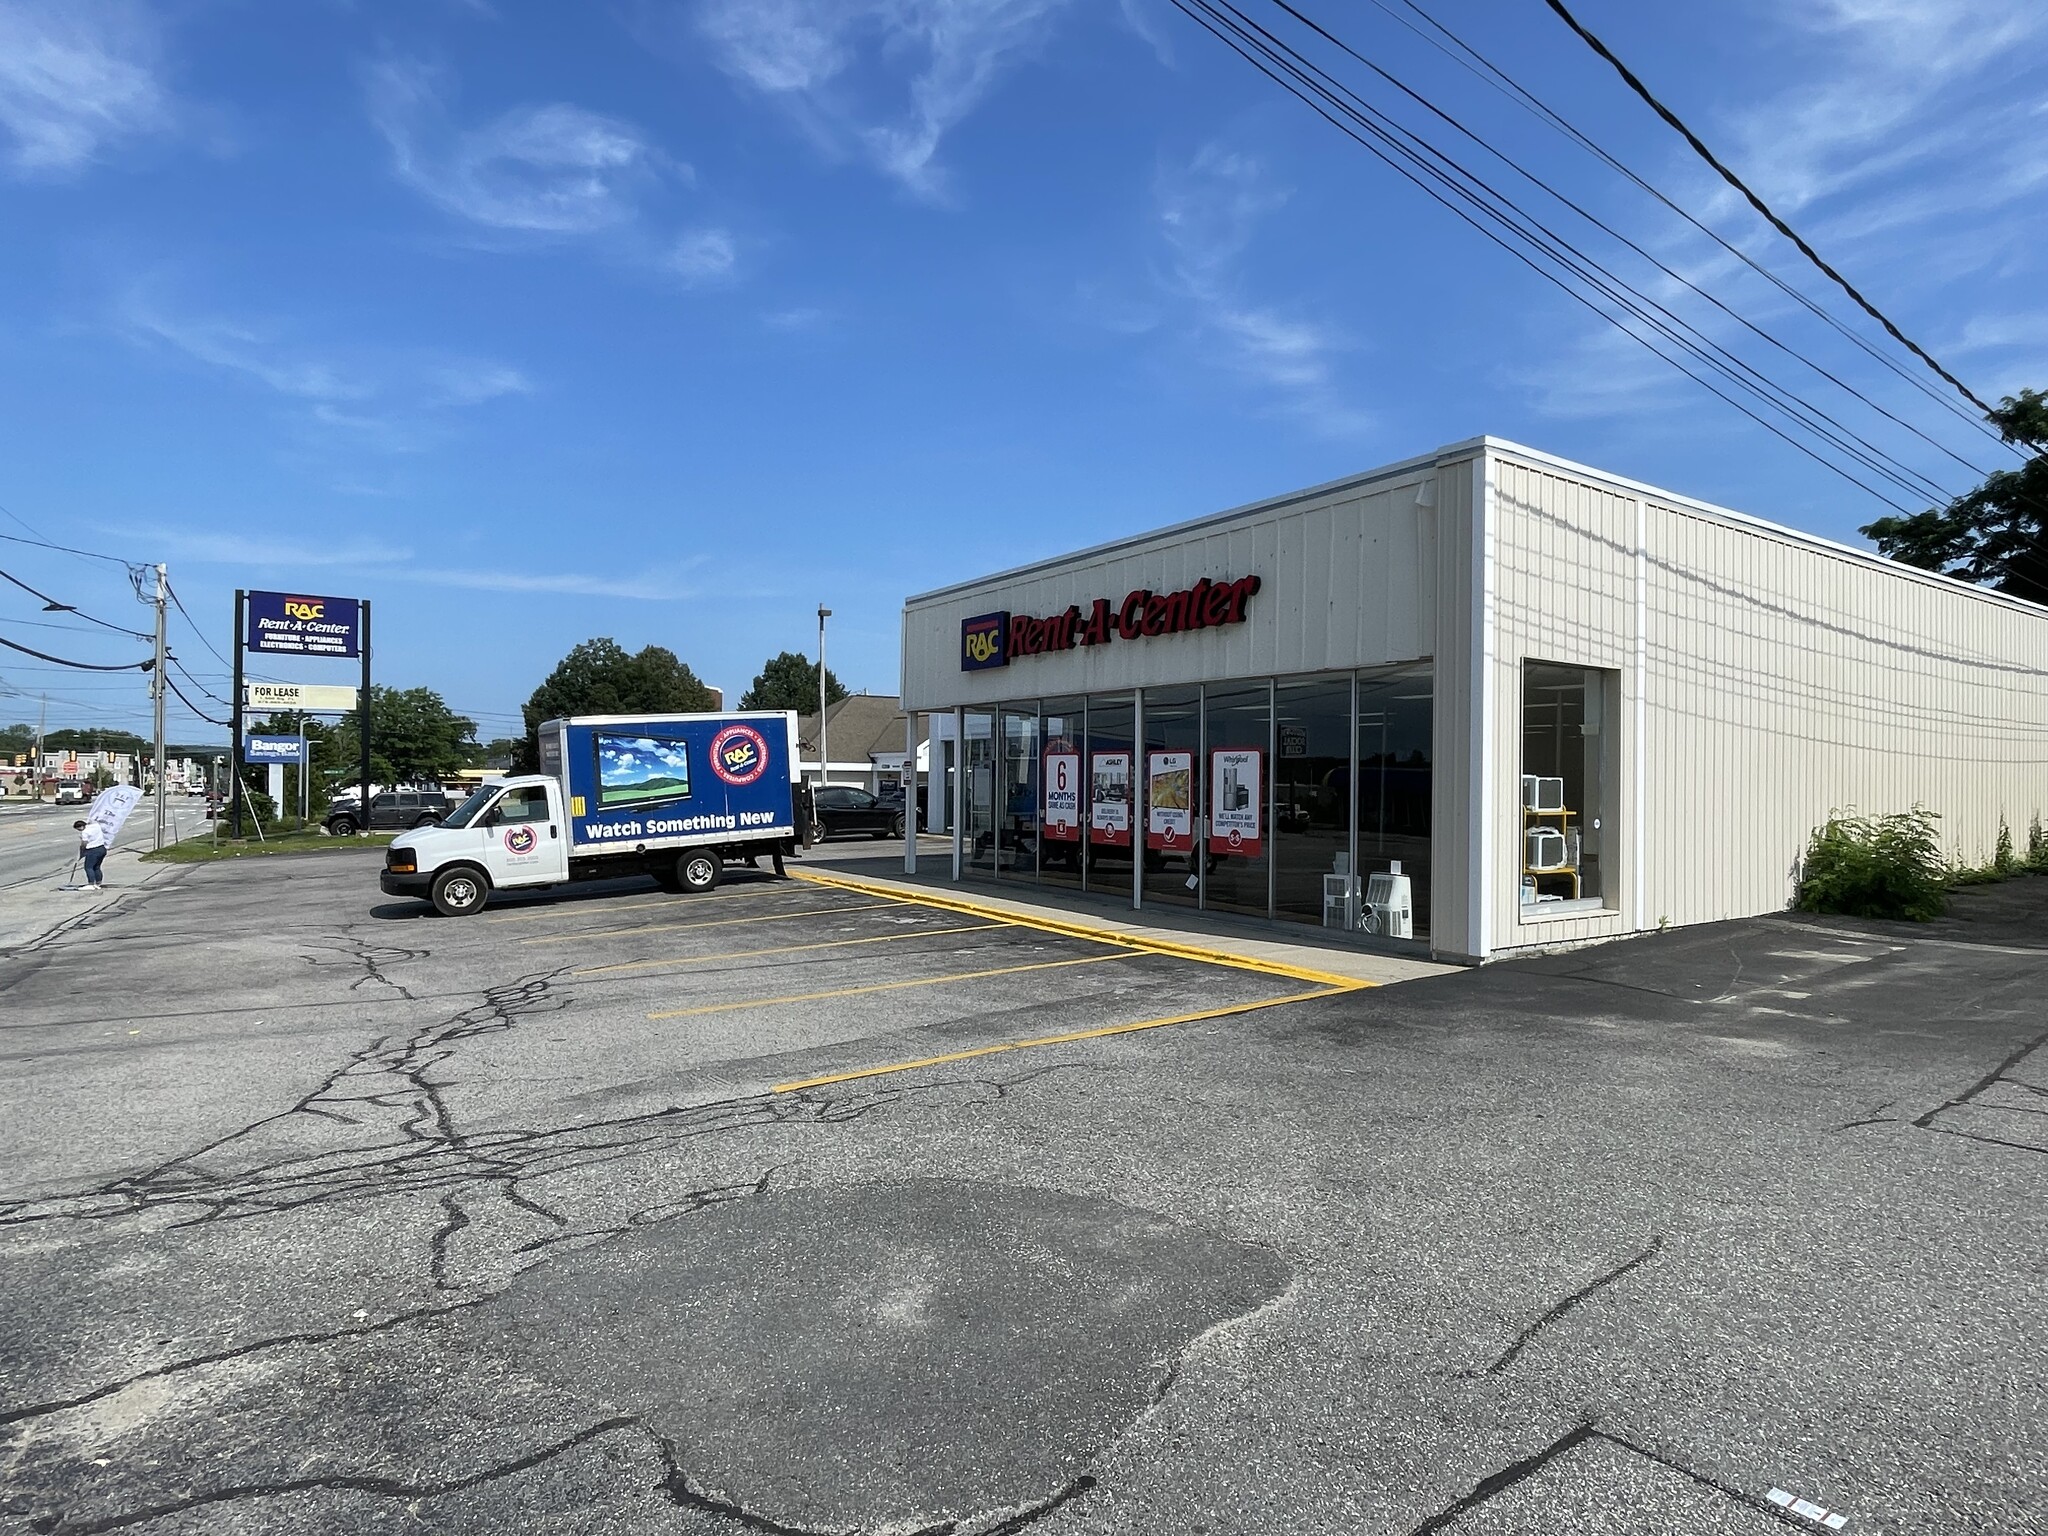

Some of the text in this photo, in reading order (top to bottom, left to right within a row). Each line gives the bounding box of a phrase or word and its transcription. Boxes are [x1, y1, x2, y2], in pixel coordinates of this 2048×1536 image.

[285, 602, 324, 620] RAC
[265, 633, 343, 644] FURNITURE APPLIANCES
[260, 641, 347, 653] ELECTRONICS COMPUTERS
[966, 629, 998, 662] RAC
[255, 687, 299, 697] FOR LEASE
[723, 727, 754, 738] APPLIANCES
[252, 740, 300, 752] Bangor
[712, 740, 721, 771] FURNITURE
[724, 743, 754, 765] RAC
[756, 738, 767, 772] ELECTRONICS
[1223, 754, 1249, 766] Whirlpool
[723, 771, 754, 783] COMPUTERS
[1057, 760, 1067, 791] 6
[1048, 792, 1076, 801] MONTHS
[585, 810, 775, 839] Watch Something New
